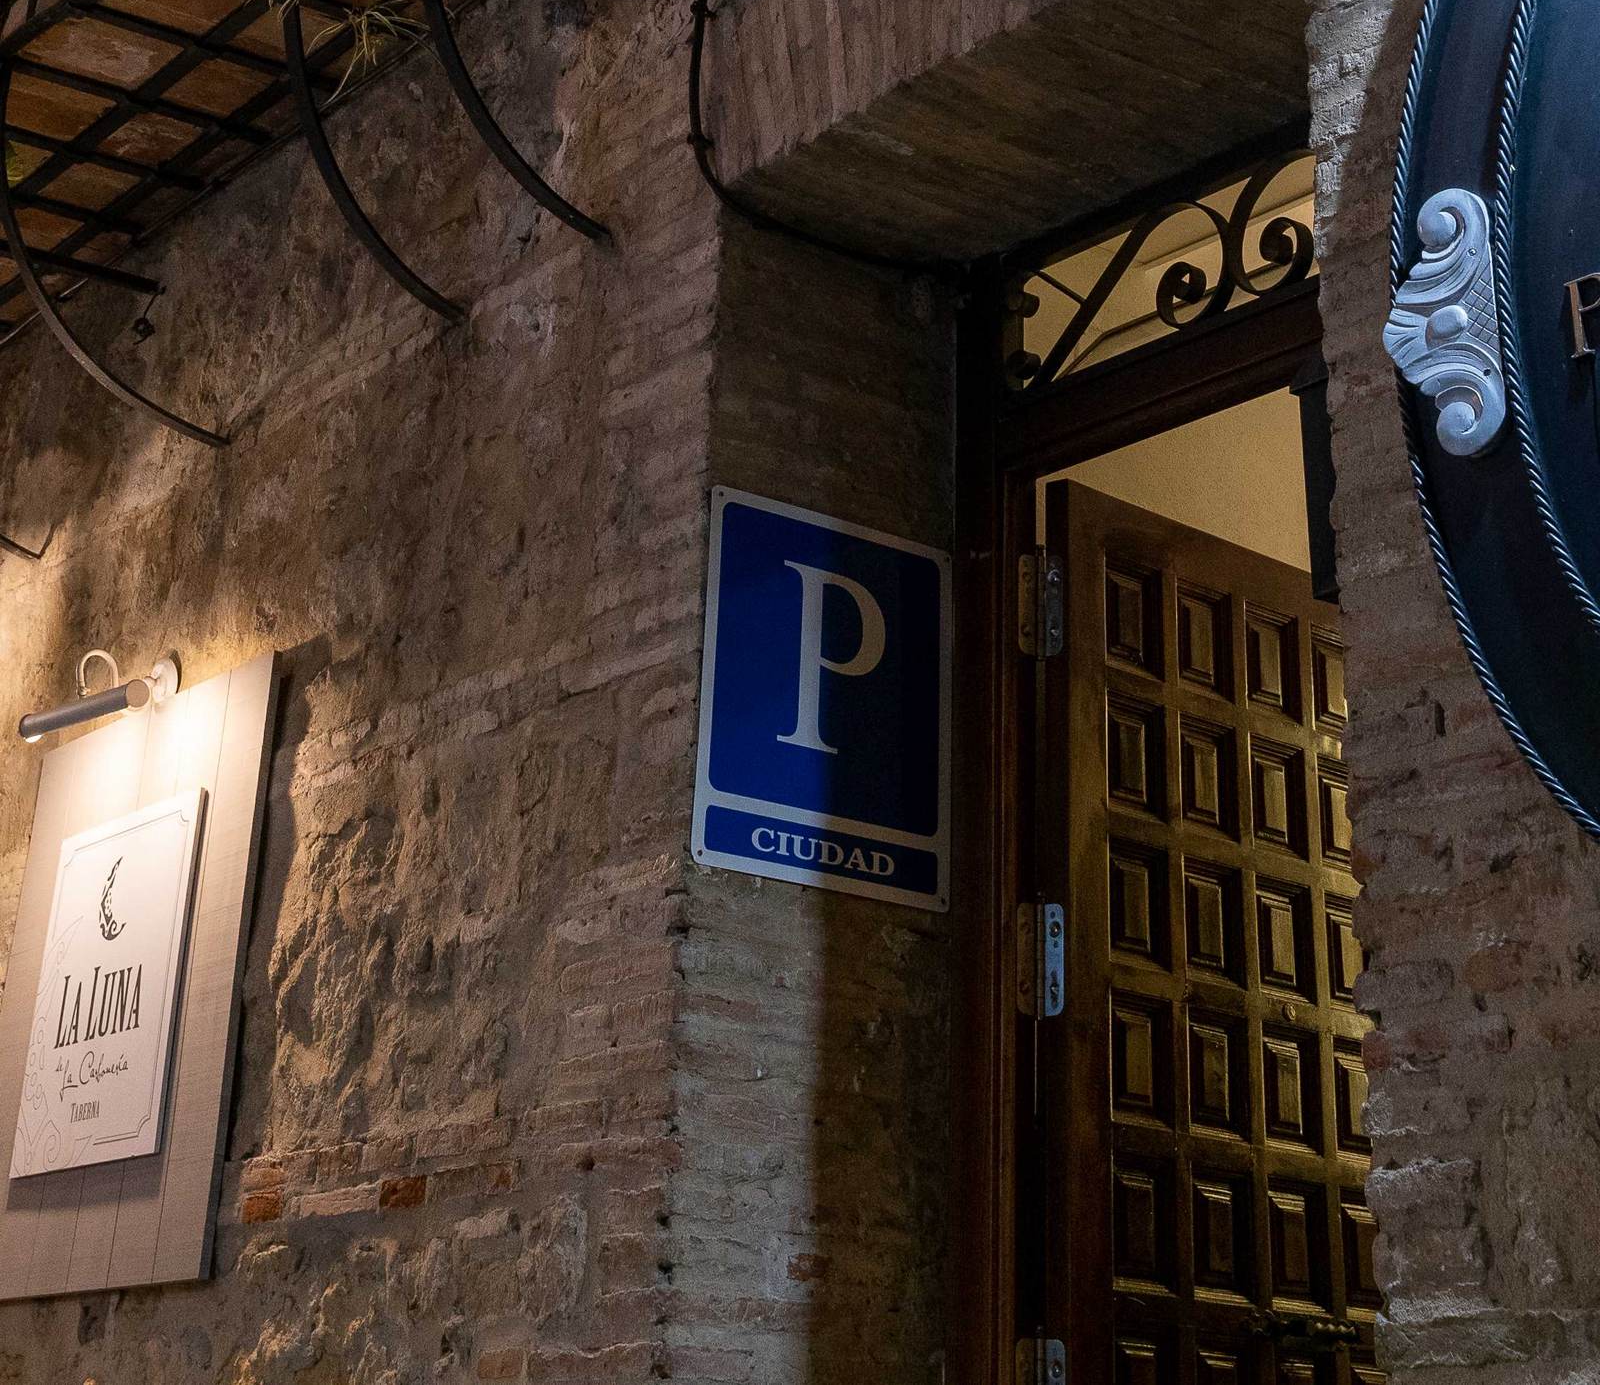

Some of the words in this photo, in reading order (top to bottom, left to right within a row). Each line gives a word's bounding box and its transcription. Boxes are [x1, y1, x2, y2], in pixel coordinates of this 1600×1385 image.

[776, 559, 887, 755] P
[751, 827, 895, 876] CIUDAD
[54, 975, 82, 1049] LA
[84, 964, 142, 1041] LUNA
[60, 1059, 79, 1102] La
[70, 1100, 100, 1124] TABERNA
